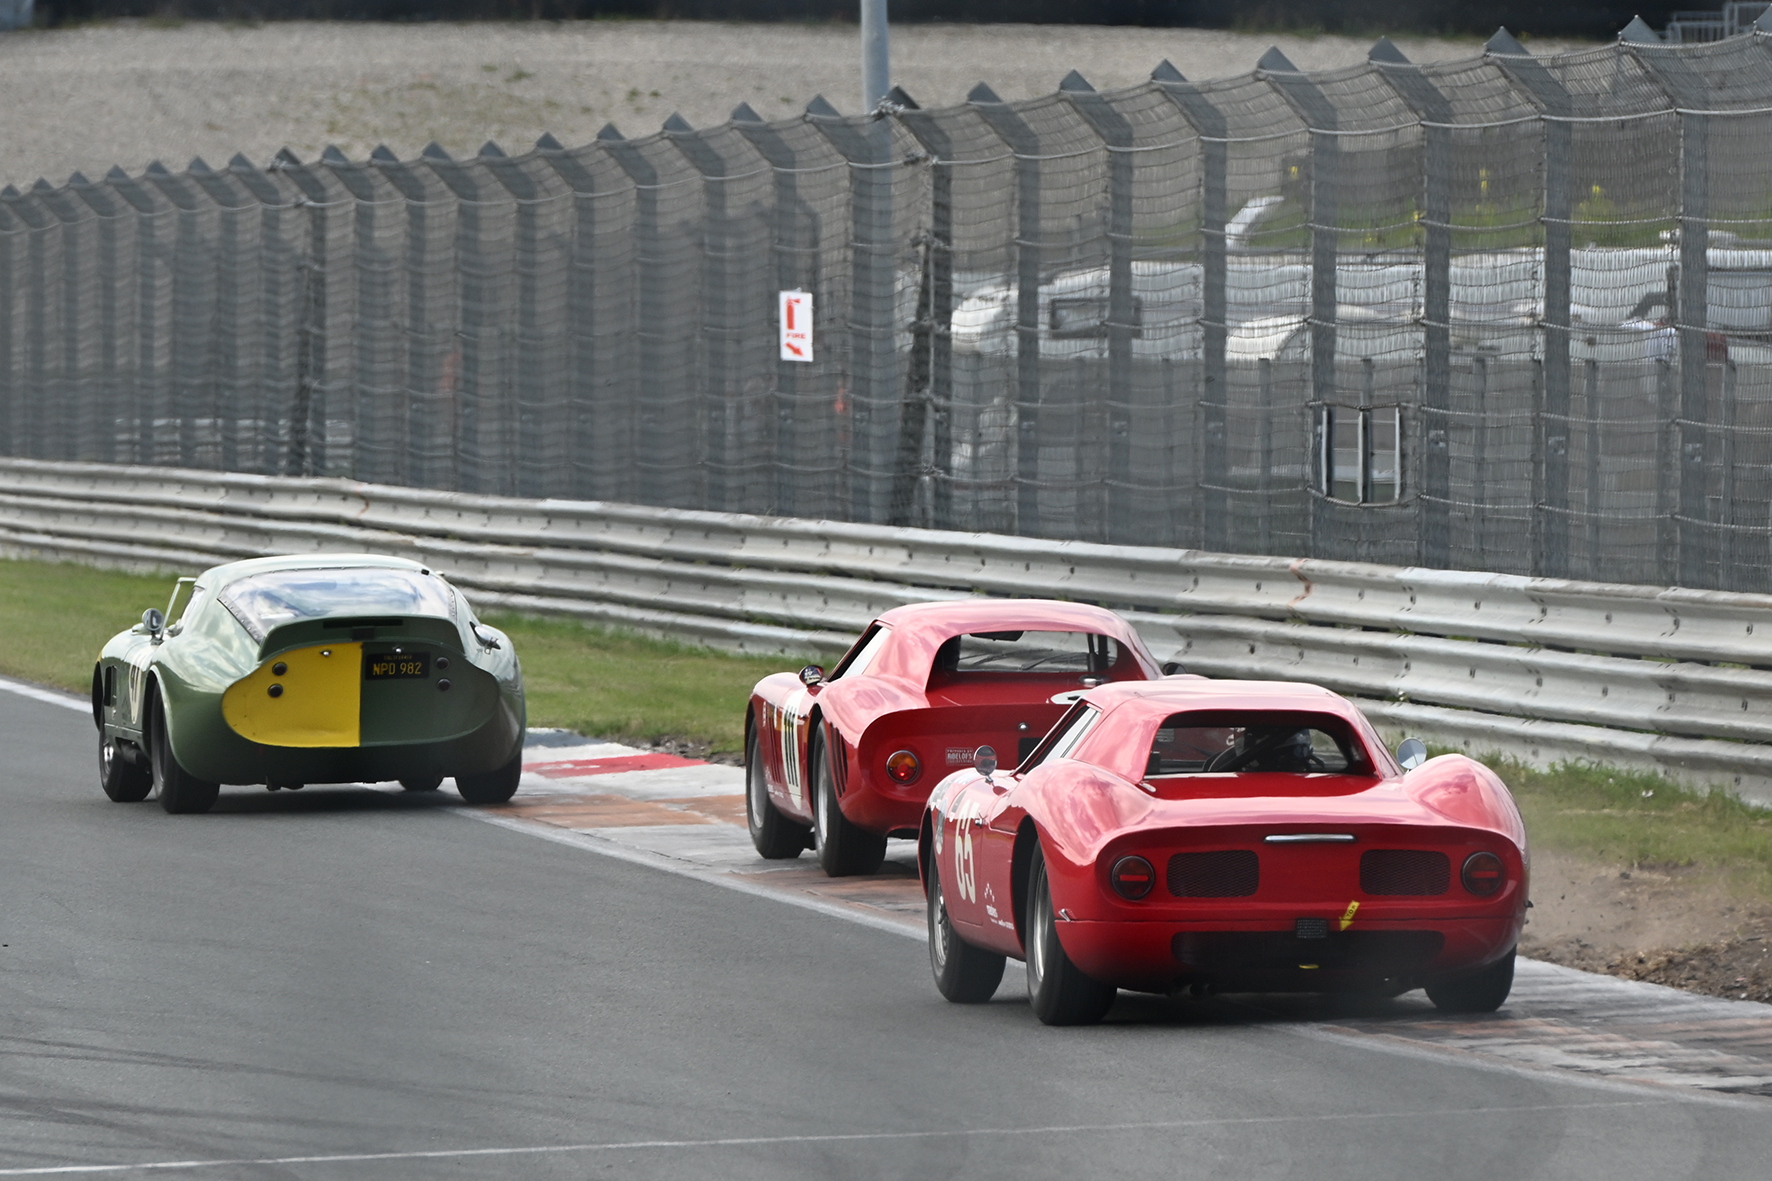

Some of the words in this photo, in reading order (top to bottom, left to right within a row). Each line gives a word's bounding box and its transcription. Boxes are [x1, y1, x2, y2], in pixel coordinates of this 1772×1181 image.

[373, 662, 396, 675] NPD
[400, 662, 422, 674] 982
[955, 799, 980, 904] 65
